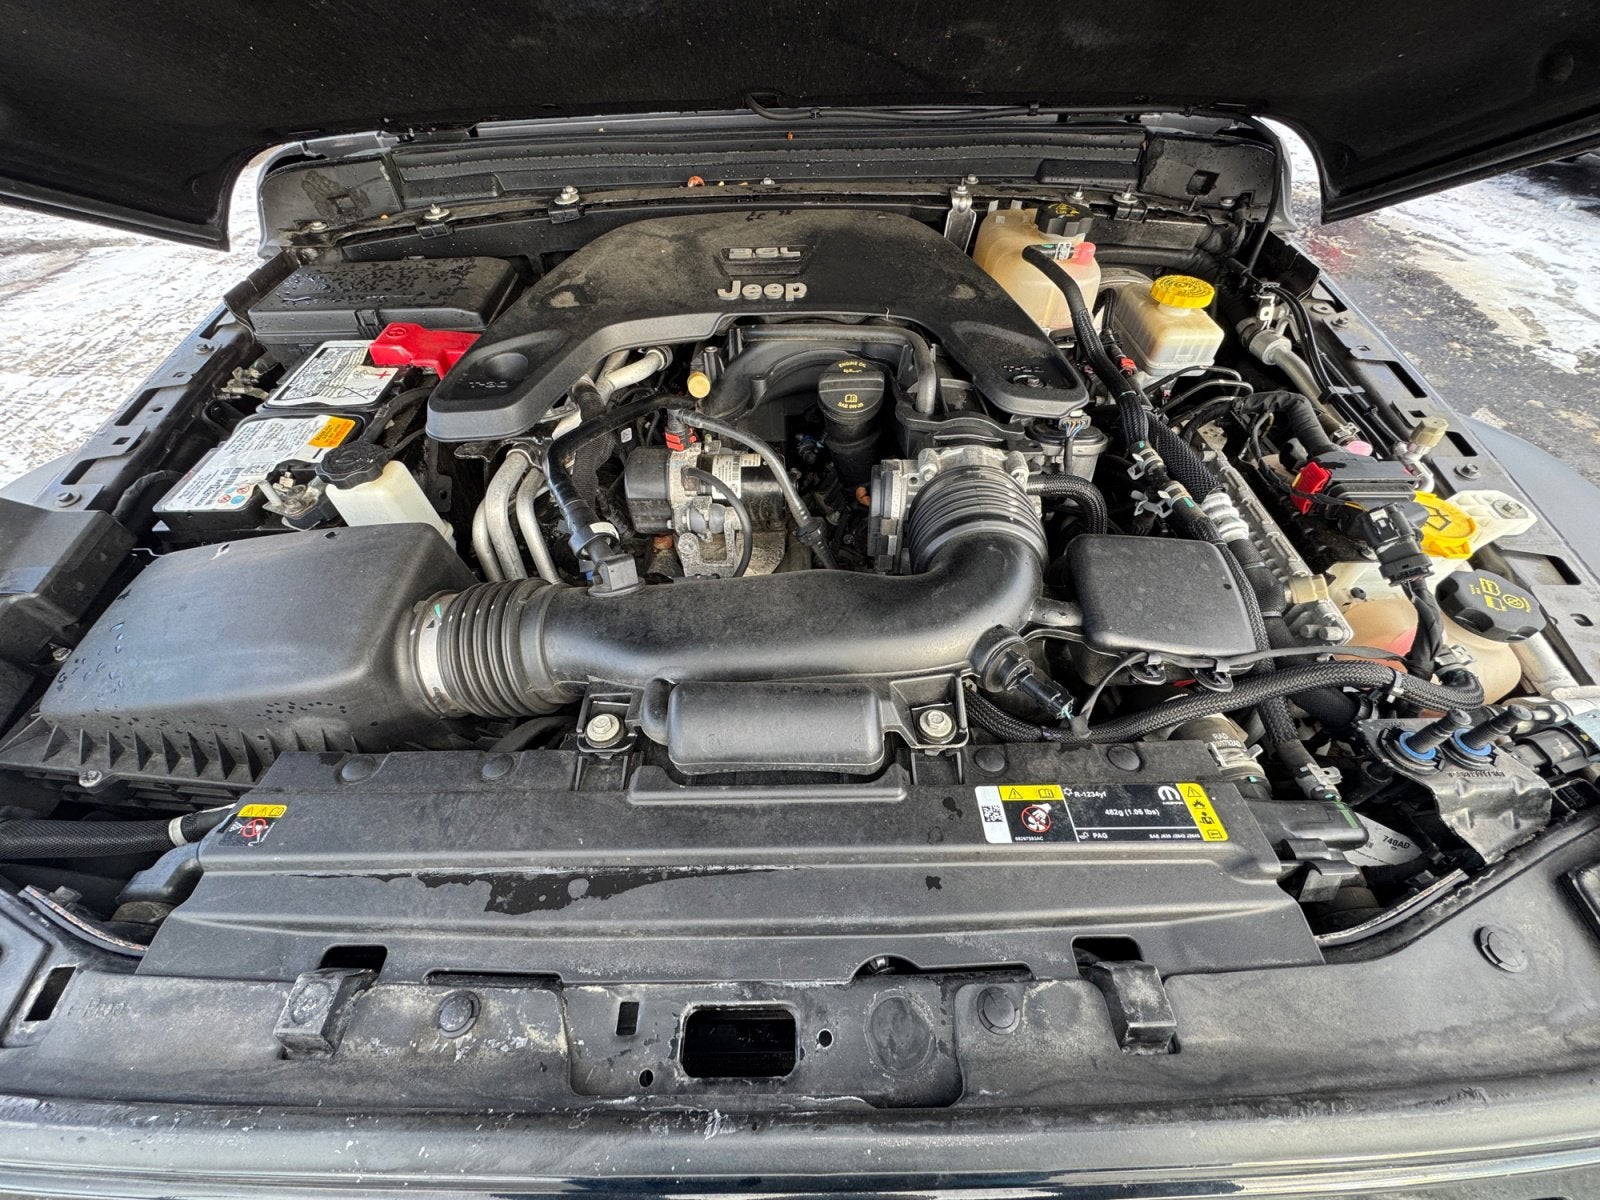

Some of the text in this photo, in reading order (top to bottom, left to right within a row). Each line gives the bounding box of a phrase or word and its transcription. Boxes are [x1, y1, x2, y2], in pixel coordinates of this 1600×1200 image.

[729, 247, 800, 259] 3.6L
[717, 280, 807, 301] Jeep
[1073, 791, 1107, 799] R-1234yf
[1092, 832, 1108, 840] PAG
